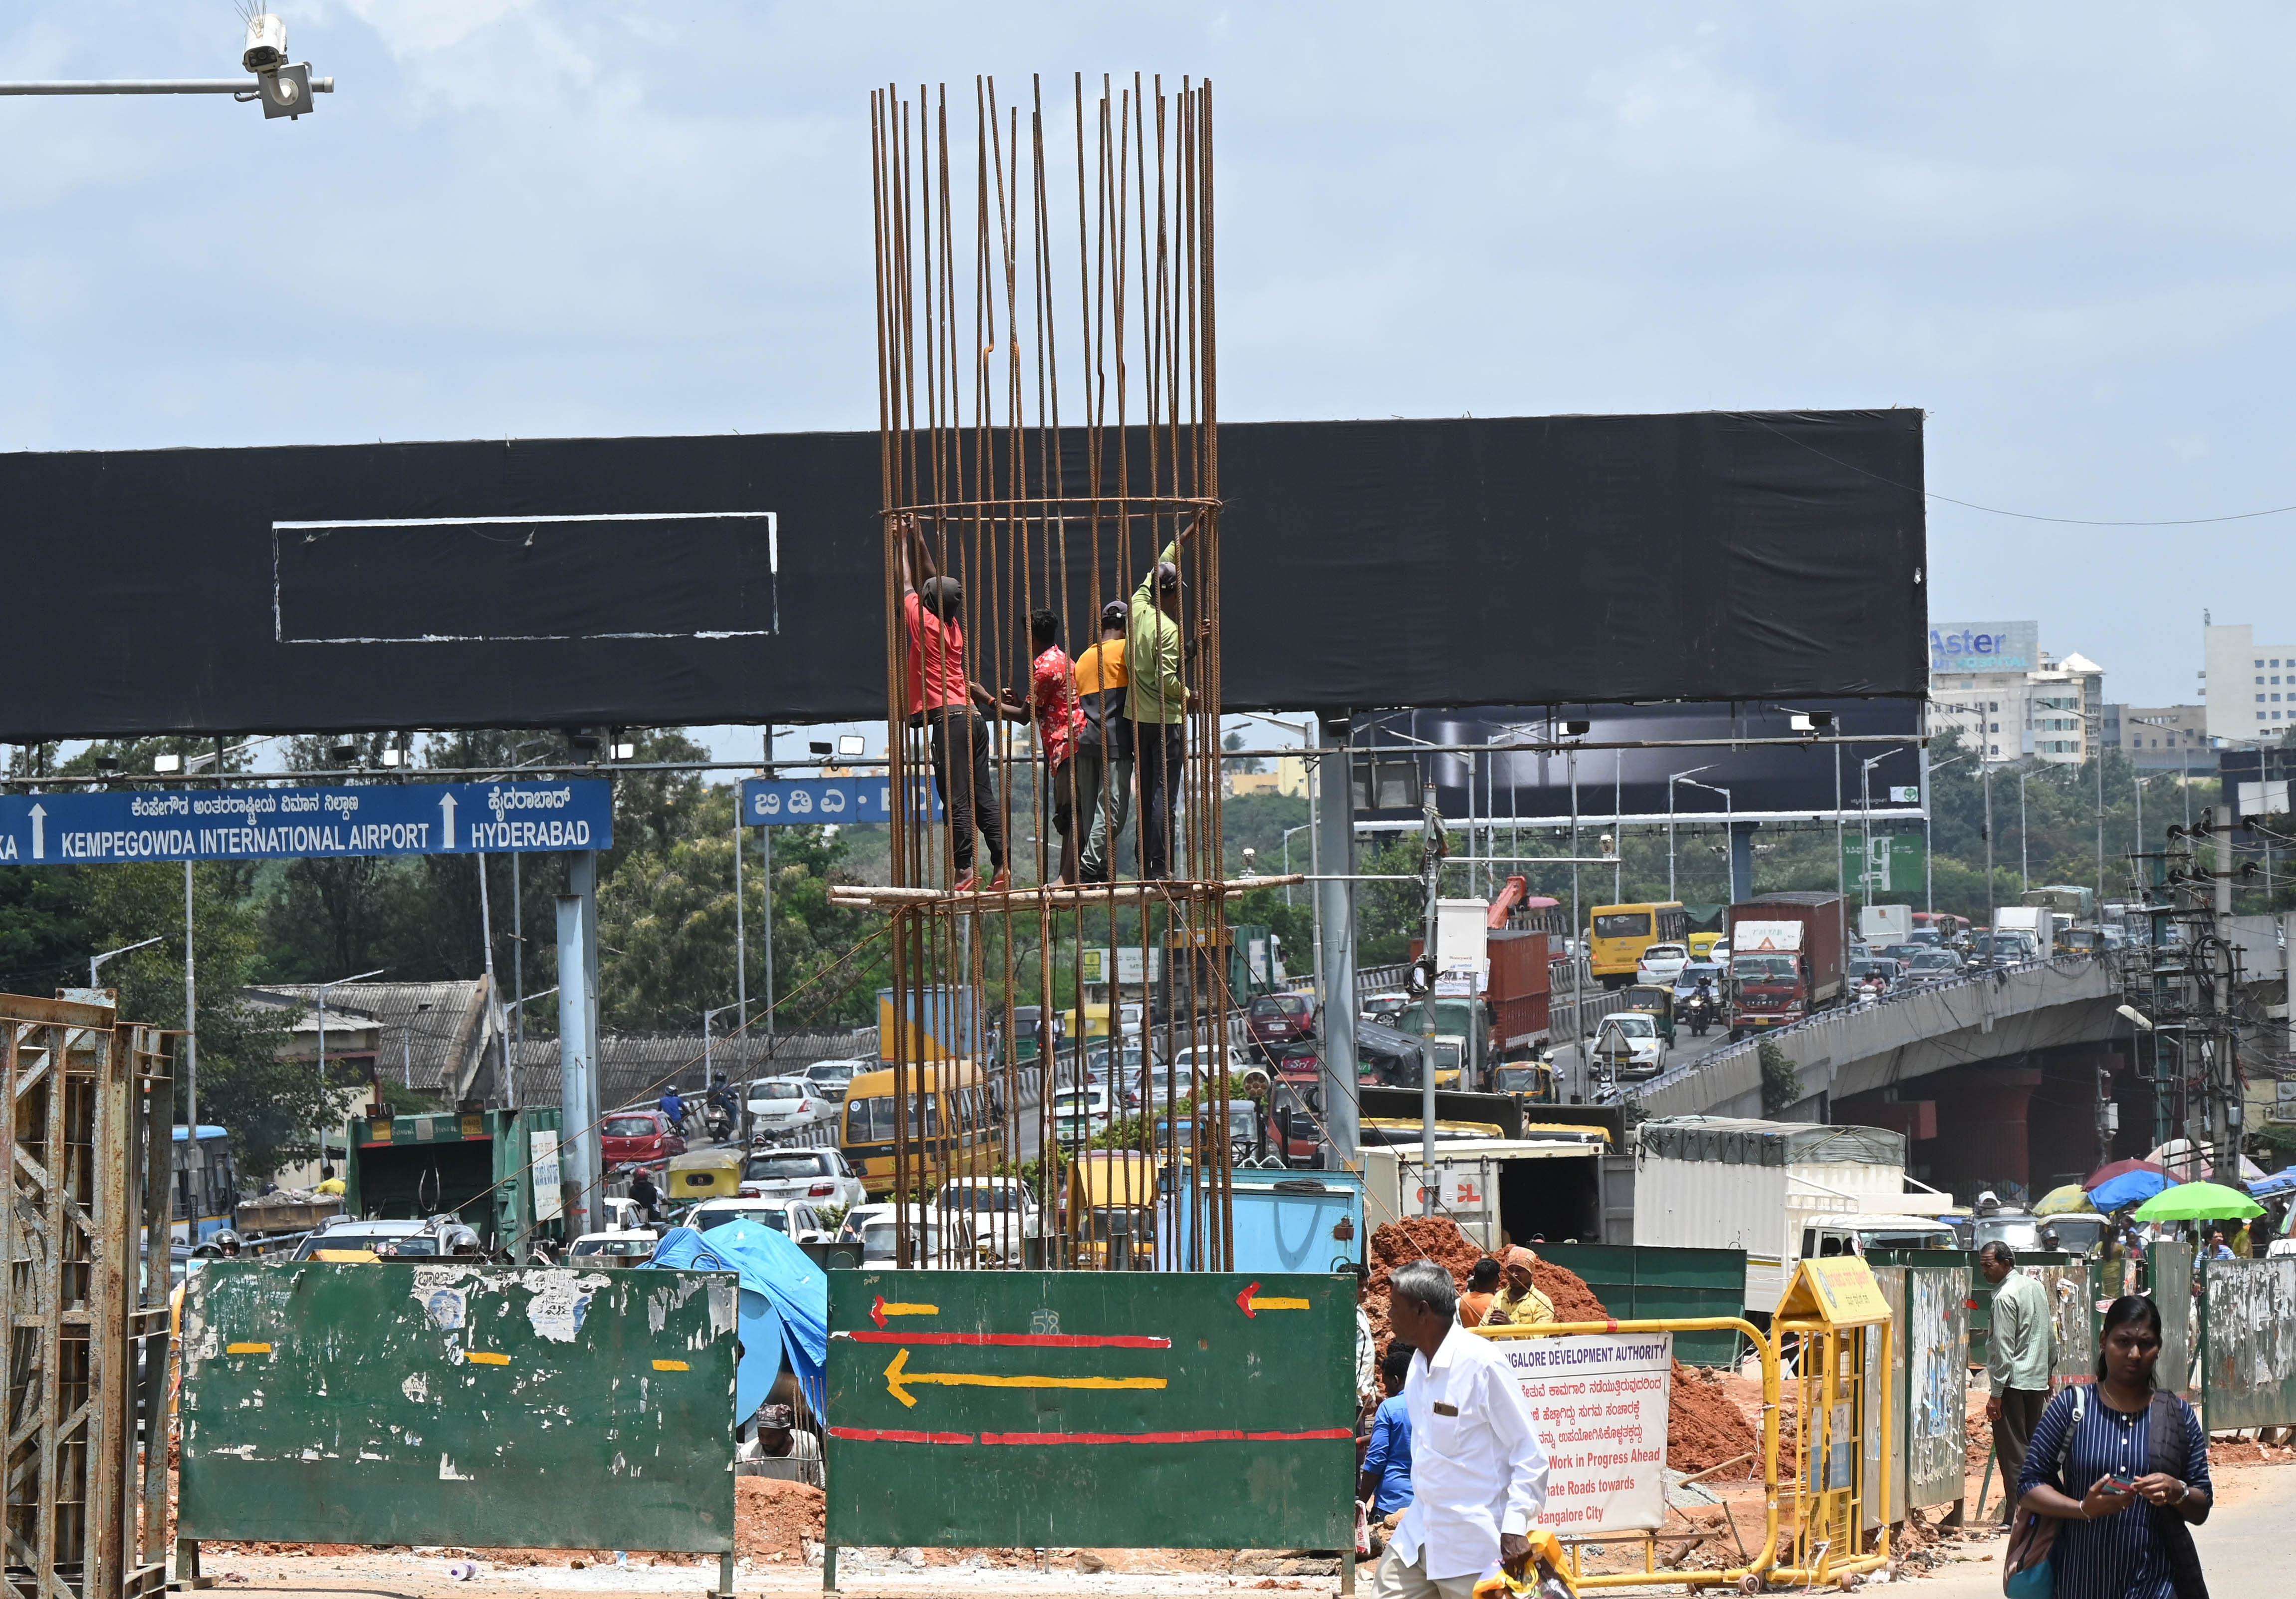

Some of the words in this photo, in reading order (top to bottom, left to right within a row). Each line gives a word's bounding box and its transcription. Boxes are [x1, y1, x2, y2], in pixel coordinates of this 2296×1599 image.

[1930, 628, 2006, 654] Aster
[132, 797, 188, 816] ಕೆಂಪೇಗೌಡ
[194, 795, 275, 825] ಅಂತರರಾಷ್ಟ್ರೀಯ
[281, 793, 319, 812] ವಿಮಾನ
[324, 795, 358, 820] ನಿಲ್ದಾಣ
[488, 786, 570, 822] ಹೈದರಾಬಾದ್
[62, 830, 196, 857] KEMPEGOWDA
[200, 826, 345, 854] INTERNATIONAL
[349, 823, 429, 850] AIRPORT
[472, 820, 590, 848] HYDERABAD
[1549, 1347, 1613, 1365] DEVELOPMENT
[1615, 1344, 1665, 1361] AUTHORITY
[1549, 1380, 1586, 1396] ಕಾಮಗಾರಿ
[1579, 1405, 1603, 1418] ಸುಗಮ
[1606, 1400, 1640, 1419] ಸಂಚಾರಕ್ಕೆ
[1549, 1454, 1573, 1470] Work
[1576, 1453, 1585, 1467] in
[1588, 1452, 1628, 1469] Progress
[1631, 1447, 1660, 1462] Ahead
[1568, 1479, 1596, 1495] Roads
[1599, 1476, 1635, 1493] towards
[1537, 1508, 1584, 1527] Bangalore
[1586, 1506, 1604, 1523] City
